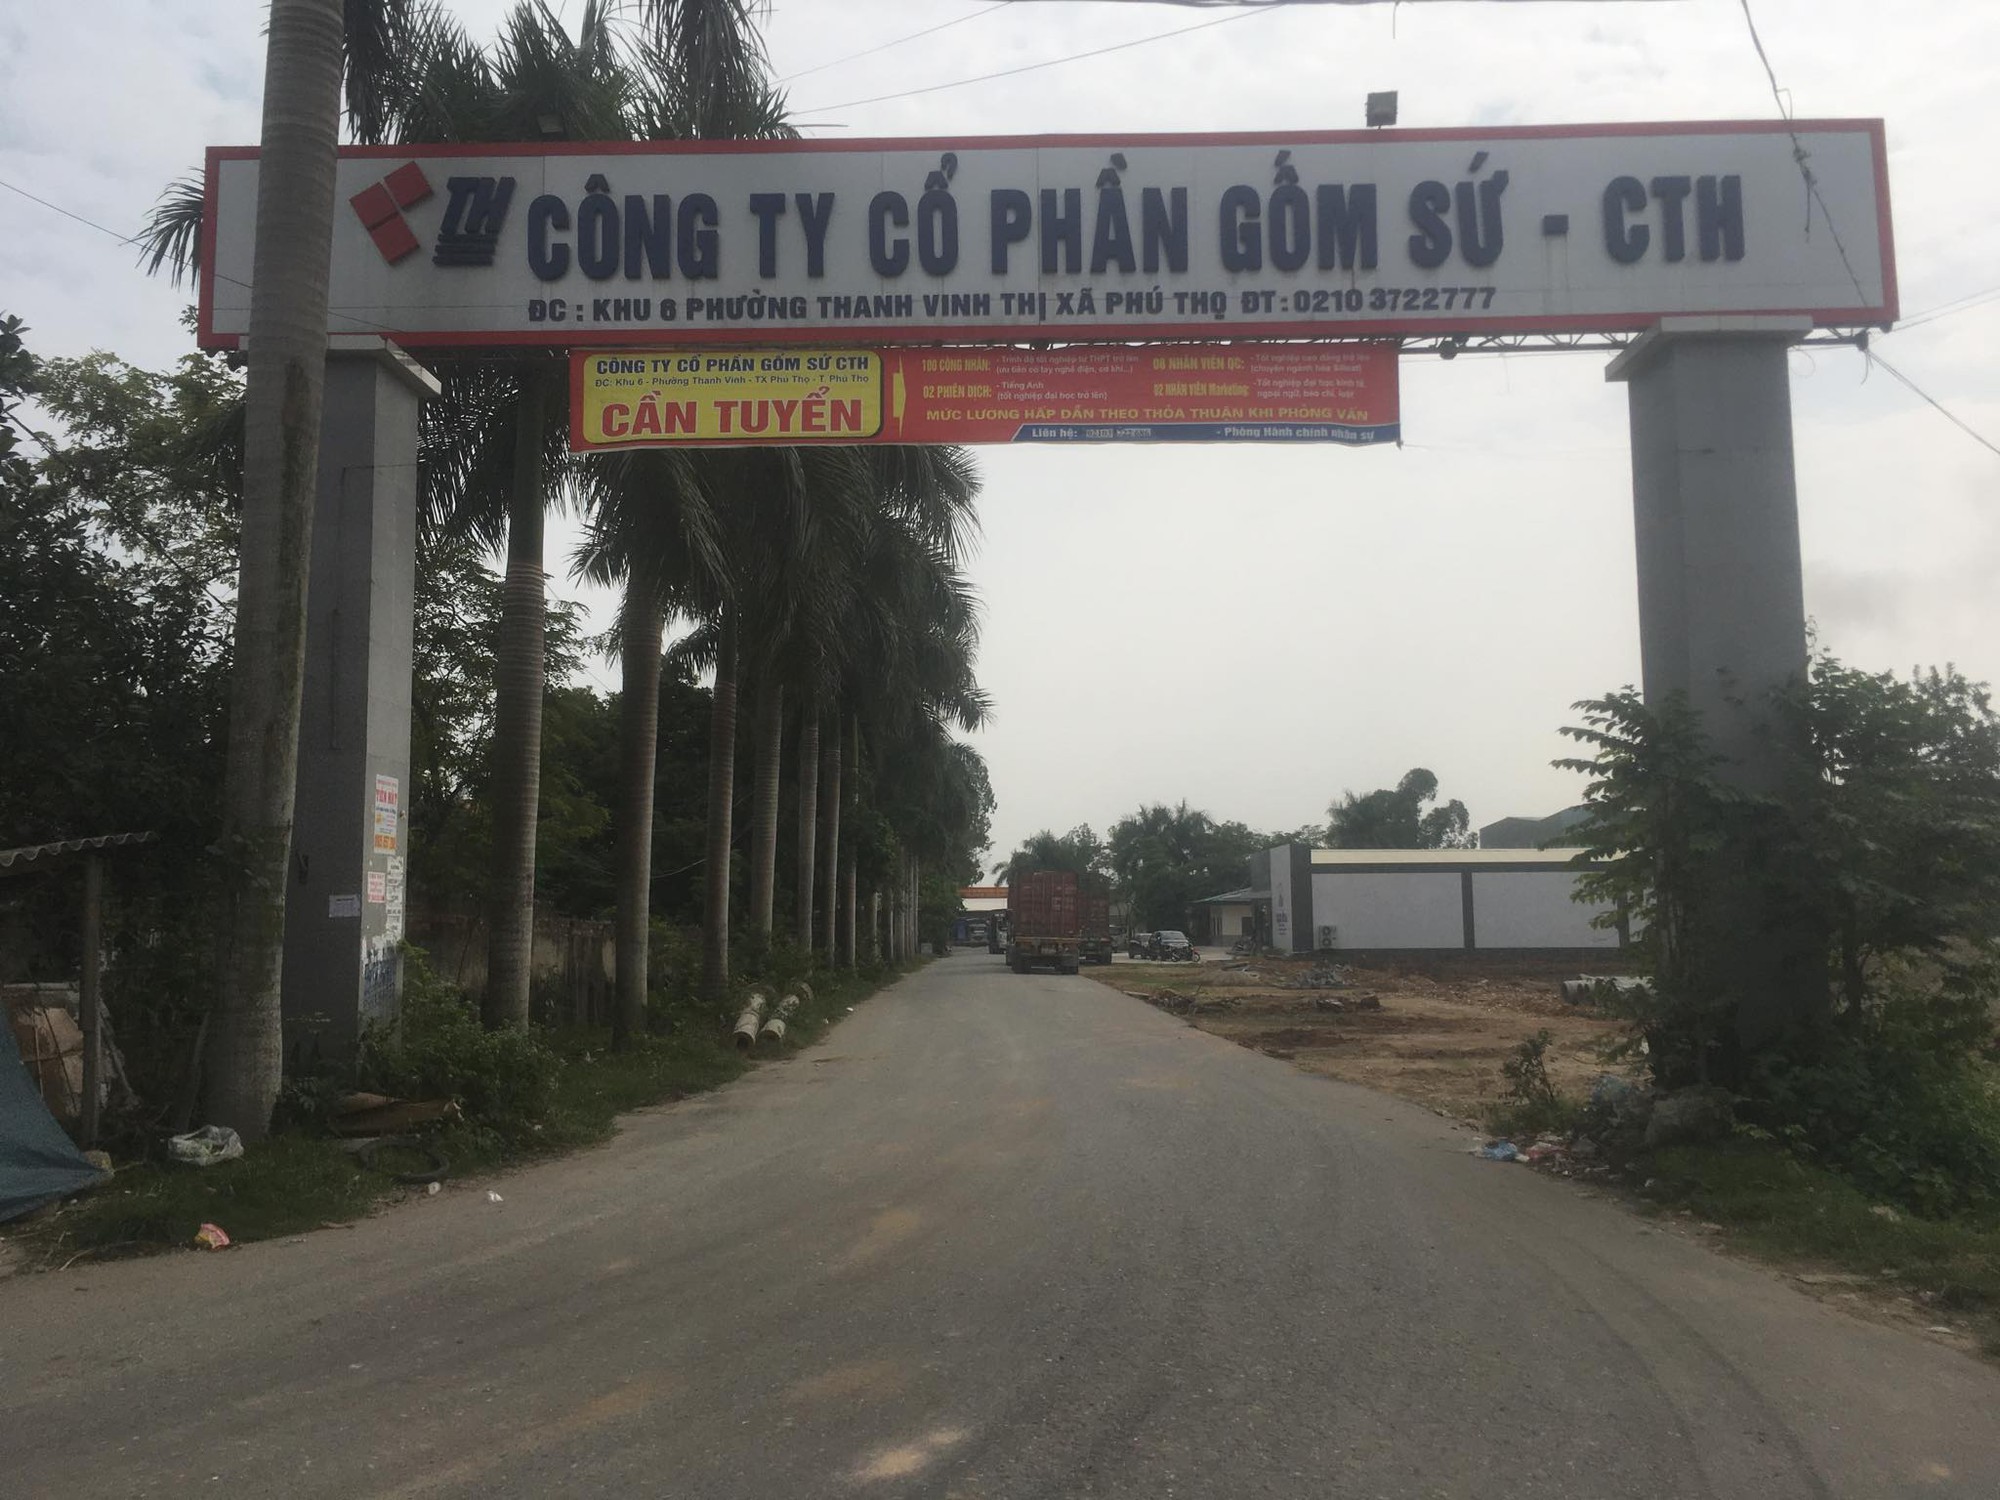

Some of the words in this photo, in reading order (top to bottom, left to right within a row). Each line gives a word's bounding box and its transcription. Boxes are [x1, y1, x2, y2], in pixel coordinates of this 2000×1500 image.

[527, 174, 719, 281] CÔNG
[749, 192, 835, 278] TY
[868, 152, 958, 277] CỔ
[990, 152, 1188, 275] PHẦN
[1219, 150, 1378, 273] GỐM
[1409, 151, 1509, 269] SỨ
[1603, 174, 1745, 264] CTH
[593, 298, 651, 322] KHU
[660, 298, 677, 322] 6
[686, 288, 807, 321] PHƯỜNG
[817, 295, 913, 320] THANH
[923, 294, 990, 317] VINH
[1000, 292, 1046, 321] THỊ
[1056, 287, 1096, 316] XÃ
[1106, 285, 1164, 316] PHÚ
[1174, 291, 1227, 320] THỌ
[1369, 287, 1496, 312] 3722777
[597, 357, 646, 375] CÔNG
[652, 359, 671, 373] TY
[706, 353, 755, 372] PHẦN
[760, 353, 801, 371] GỐM
[807, 353, 832, 371] SỨ
[836, 356, 869, 371] CTH
[922, 359, 937, 372] 100
[939, 356, 963, 372] CÔNG
[615, 378, 635, 387] Khu
[637, 378, 644, 386] 6
[652, 376, 689, 387] Phường
[692, 376, 722, 385] Thanh
[724, 375, 747, 385] Vinh
[755, 376, 767, 384] TX
[1026, 382, 1044, 390] Anh
[923, 385, 935, 399] 02
[602, 390, 698, 438] CẦN
[713, 386, 863, 434] TUYỂN
[927, 407, 962, 421] MỨC
[966, 408, 1020, 421] LƯƠNG
[1099, 408, 1139, 419] THEO
[1189, 406, 1243, 421] THUẬN
[1248, 407, 1273, 418] KHI
[1032, 427, 1057, 438] Liên
